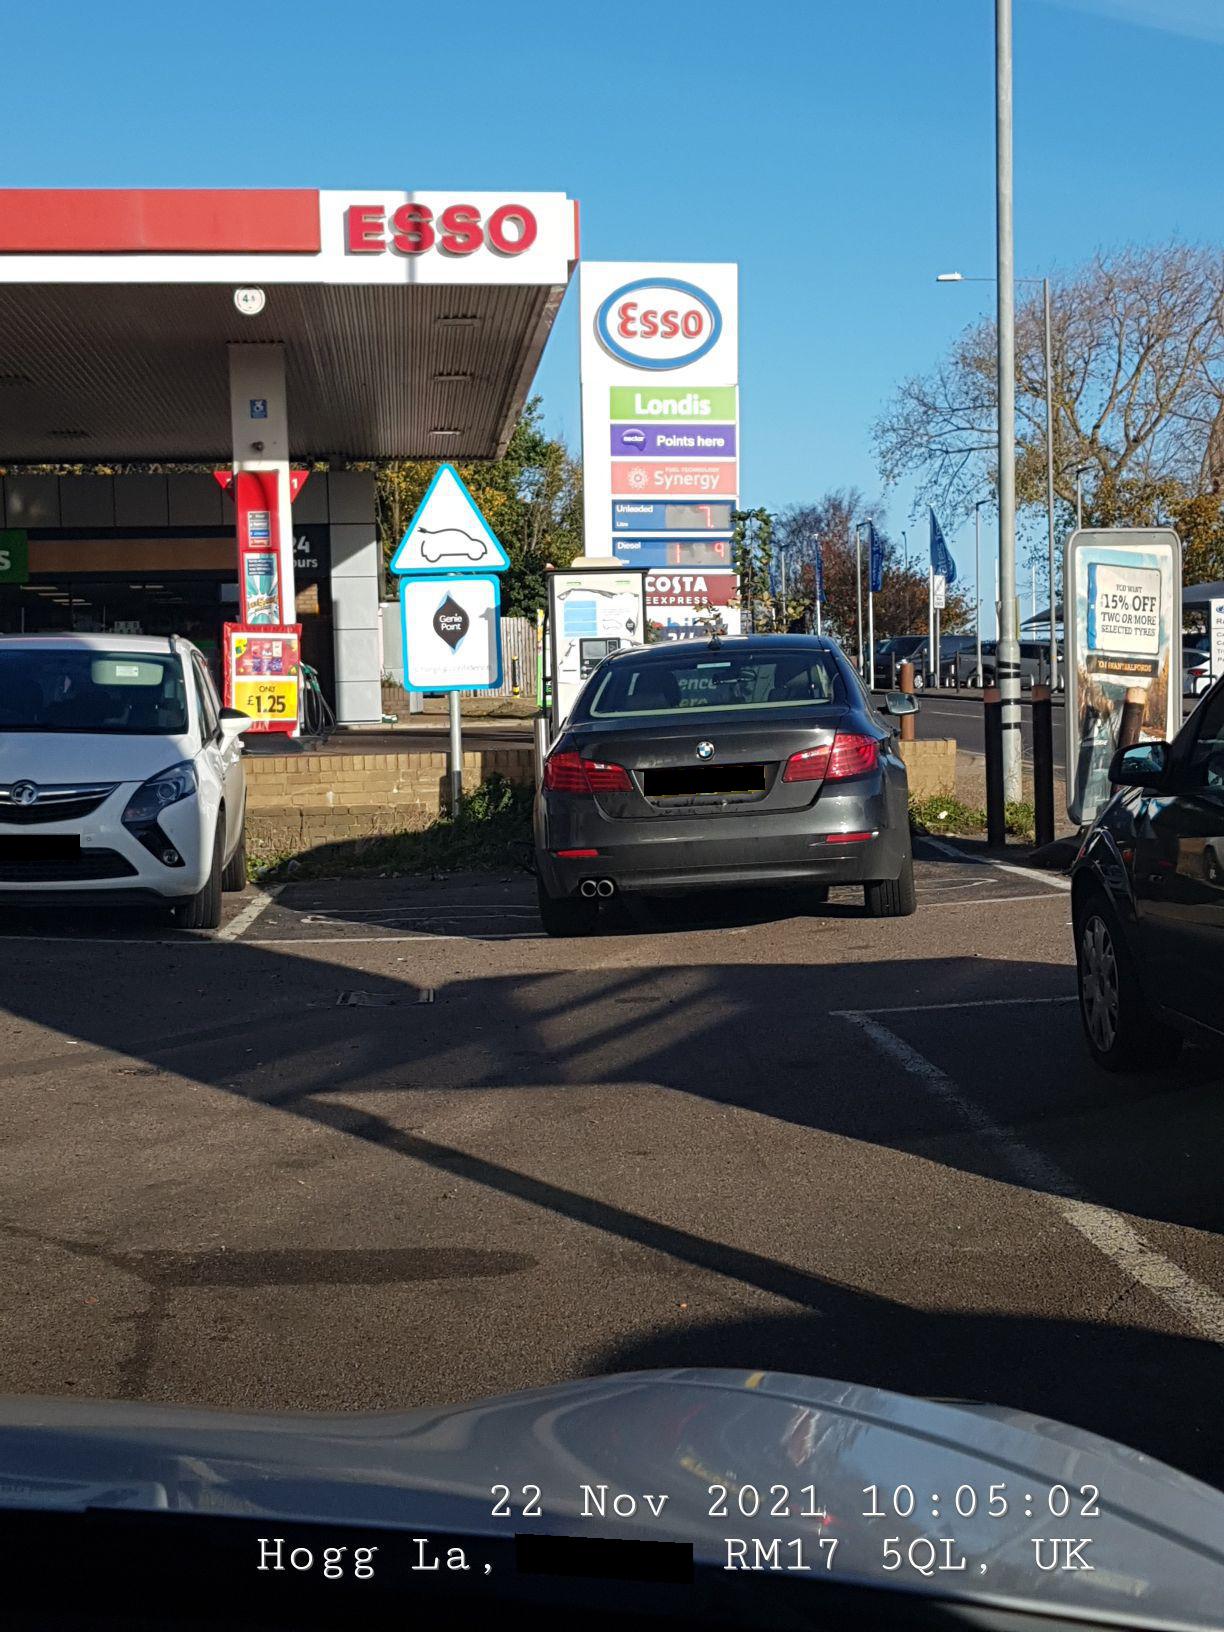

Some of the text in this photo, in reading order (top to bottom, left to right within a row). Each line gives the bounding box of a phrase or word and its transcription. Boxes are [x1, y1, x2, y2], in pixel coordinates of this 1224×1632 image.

[345, 203, 538, 256] ESSO
[617, 301, 704, 339] Esso
[634, 393, 712, 416] Londis
[656, 435, 725, 447] Points here
[654, 471, 720, 490] Synergy
[616, 504, 654, 513] Unleaded
[617, 541, 641, 550] Diesel
[645, 576, 708, 594] COSTA
[1132, 595, 1157, 613] OFF
[439, 613, 462, 623] Genie
[1121, 613, 1132, 624] OR
[1134, 615, 1156, 626] MORE
[441, 623, 461, 631] Point
[1101, 625, 1156, 637] SELECTED TYRES
